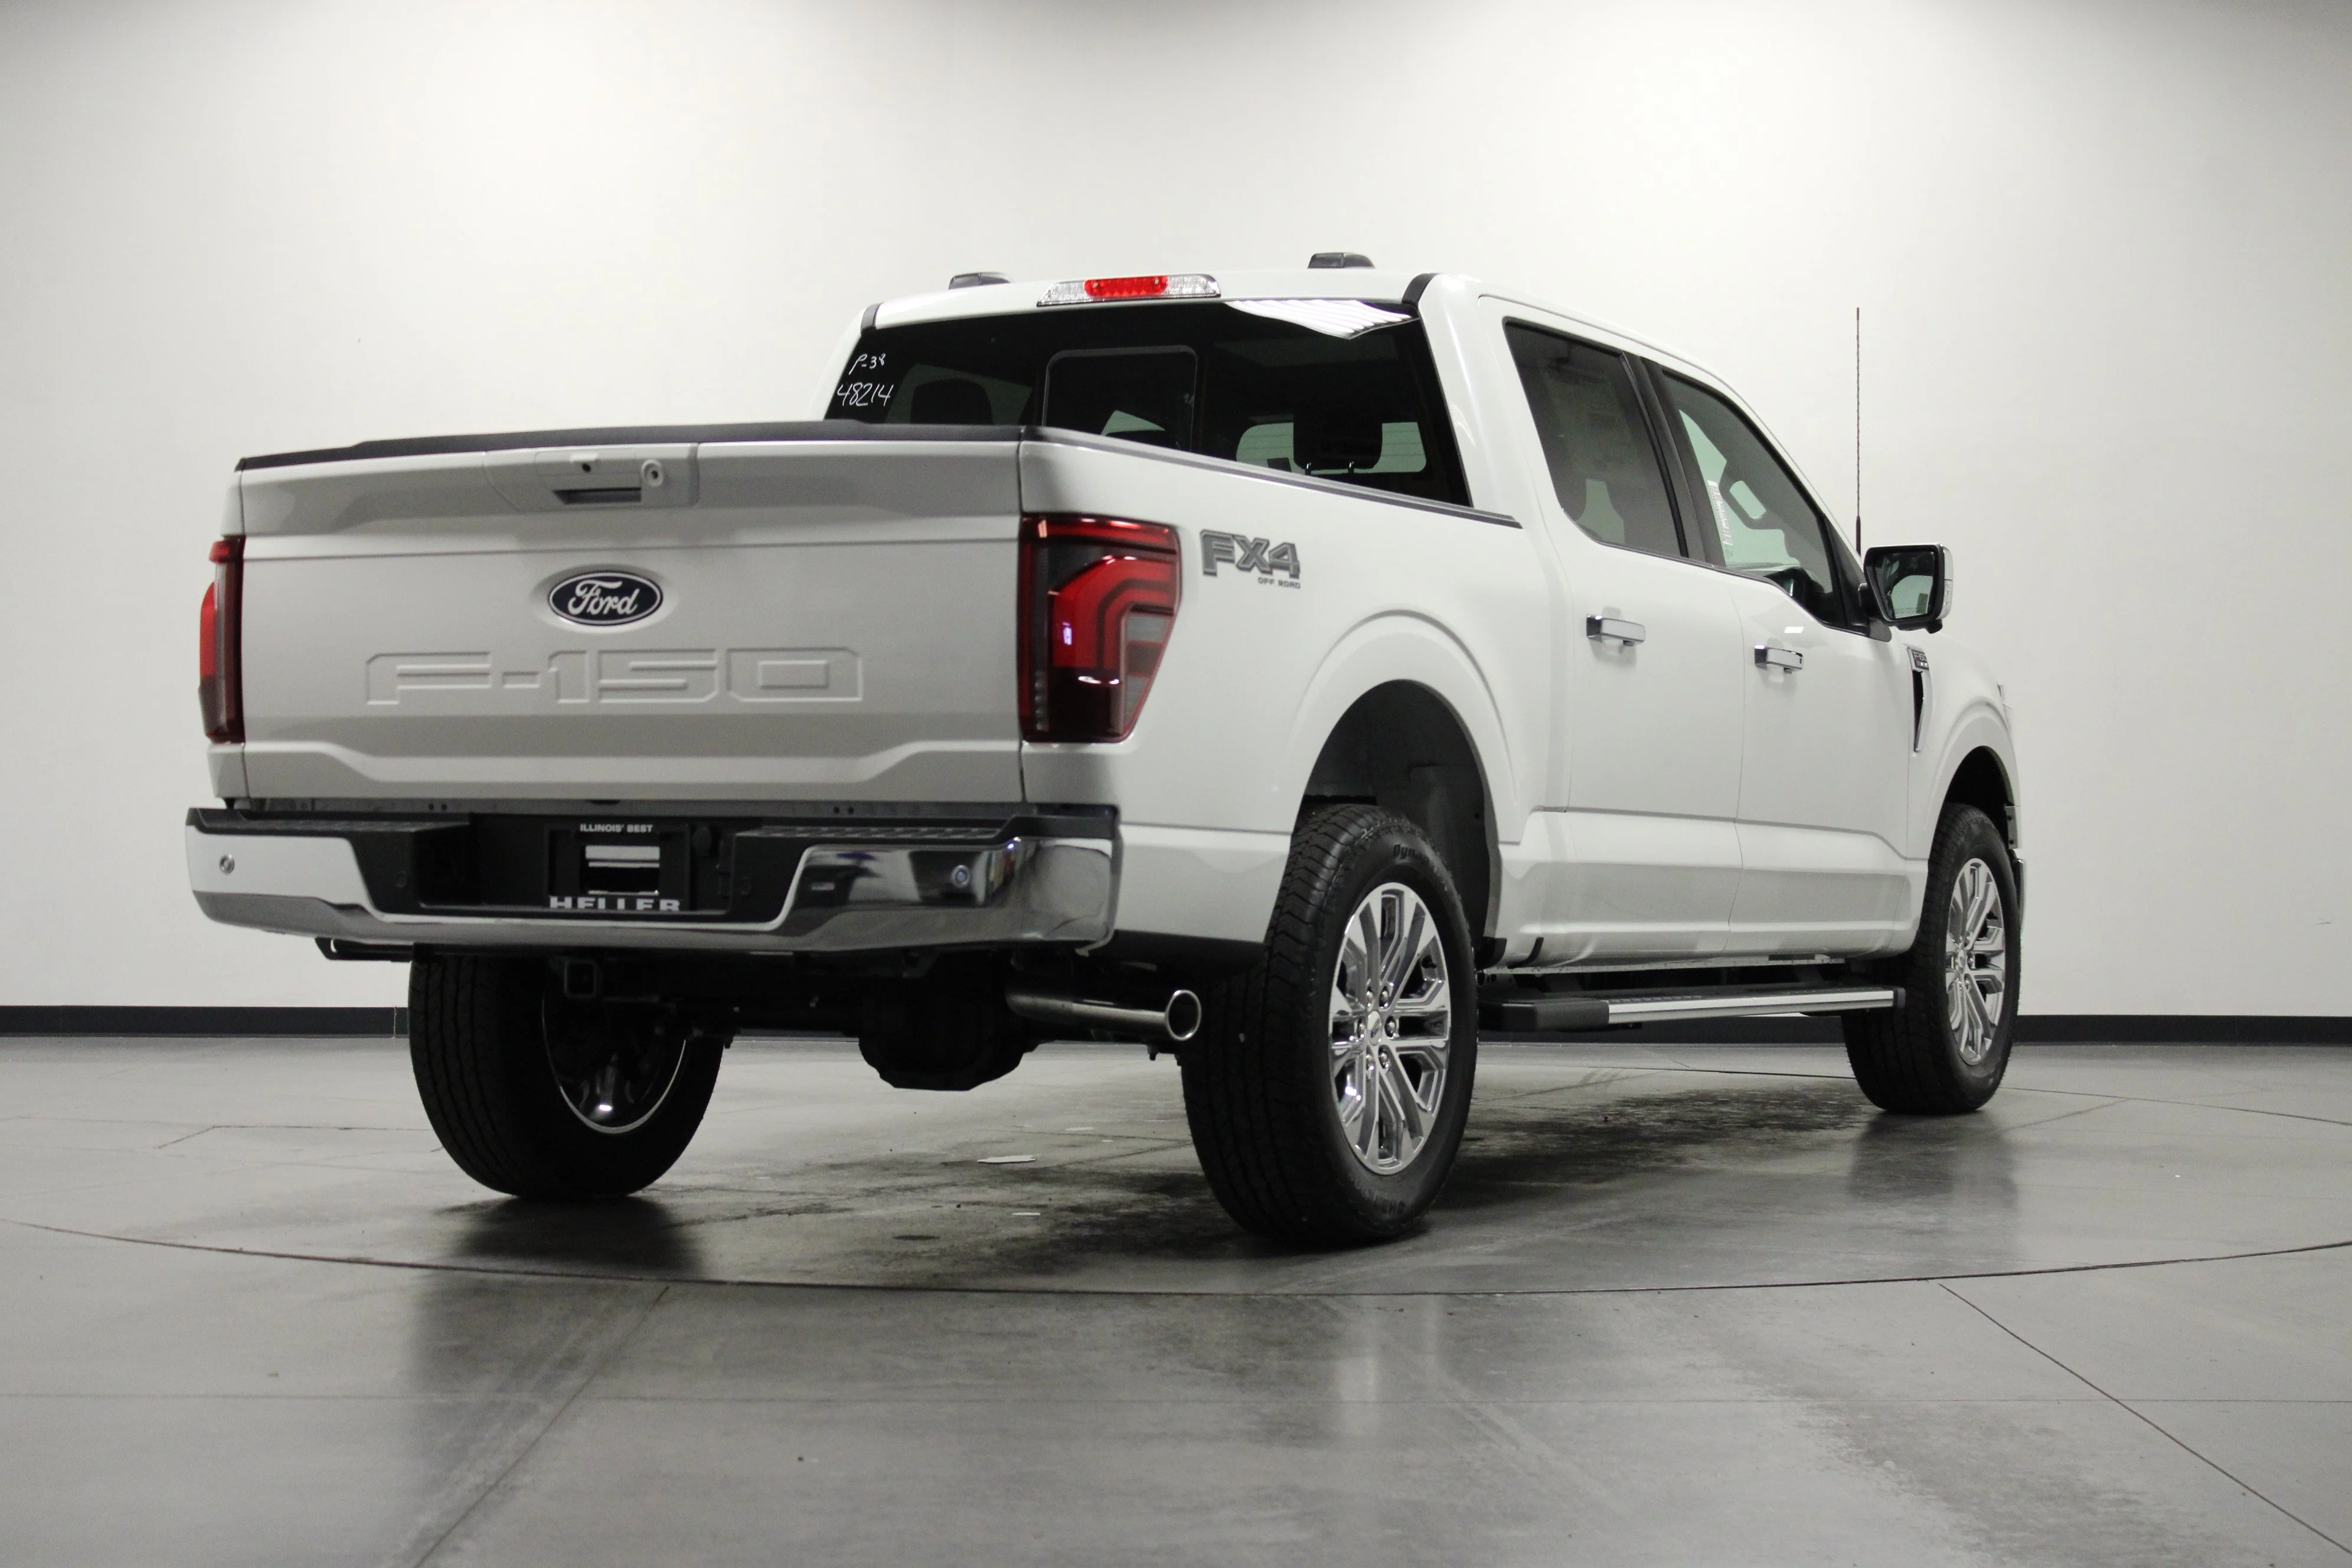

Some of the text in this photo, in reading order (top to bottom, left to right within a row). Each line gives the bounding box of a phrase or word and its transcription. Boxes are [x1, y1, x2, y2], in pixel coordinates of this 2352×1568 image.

[848, 353, 886, 375] P-38
[837, 381, 894, 407] 48214
[1200, 529, 1301, 579] FX4
[1257, 576, 1301, 590] OFF ROAD
[567, 579, 641, 615] Ford
[365, 646, 864, 706] F-150
[626, 824, 653, 833] BEST
[549, 896, 680, 911] HELLER
